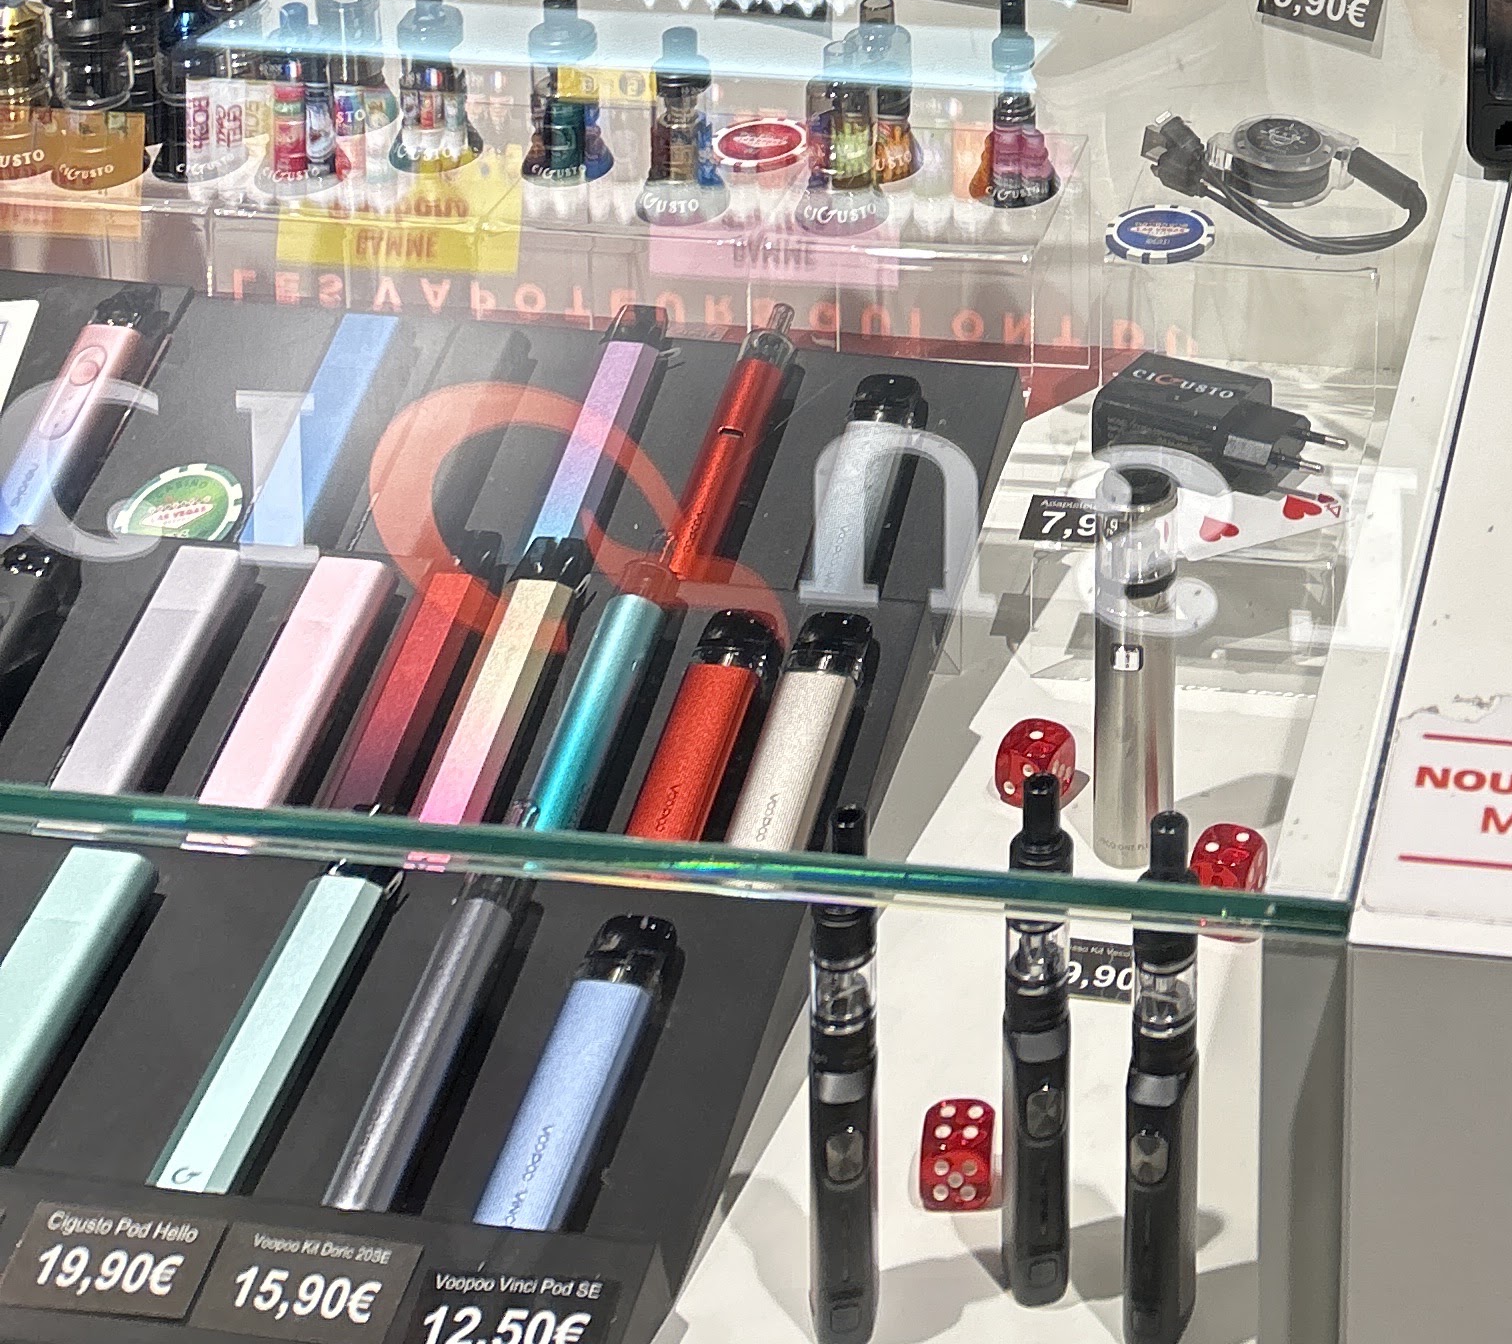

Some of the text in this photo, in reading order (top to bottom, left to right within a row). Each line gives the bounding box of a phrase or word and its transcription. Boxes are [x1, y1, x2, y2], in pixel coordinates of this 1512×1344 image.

[803, 201, 878, 226] CIGUSTO
[1131, 368, 1235, 400] CIGUSTO
[1040, 510, 1096, 540] 7,9
[46, 1210, 199, 1244] Cigusto Pod Hello
[252, 1232, 300, 1252] Voopoo
[300, 1236, 320, 1254] Kit
[320, 1239, 355, 1260] Doric
[36, 1242, 185, 1297] 19,90€
[232, 1265, 383, 1325] 15,90€
[434, 1272, 603, 1302] Voopoo Vinci Pod SE
